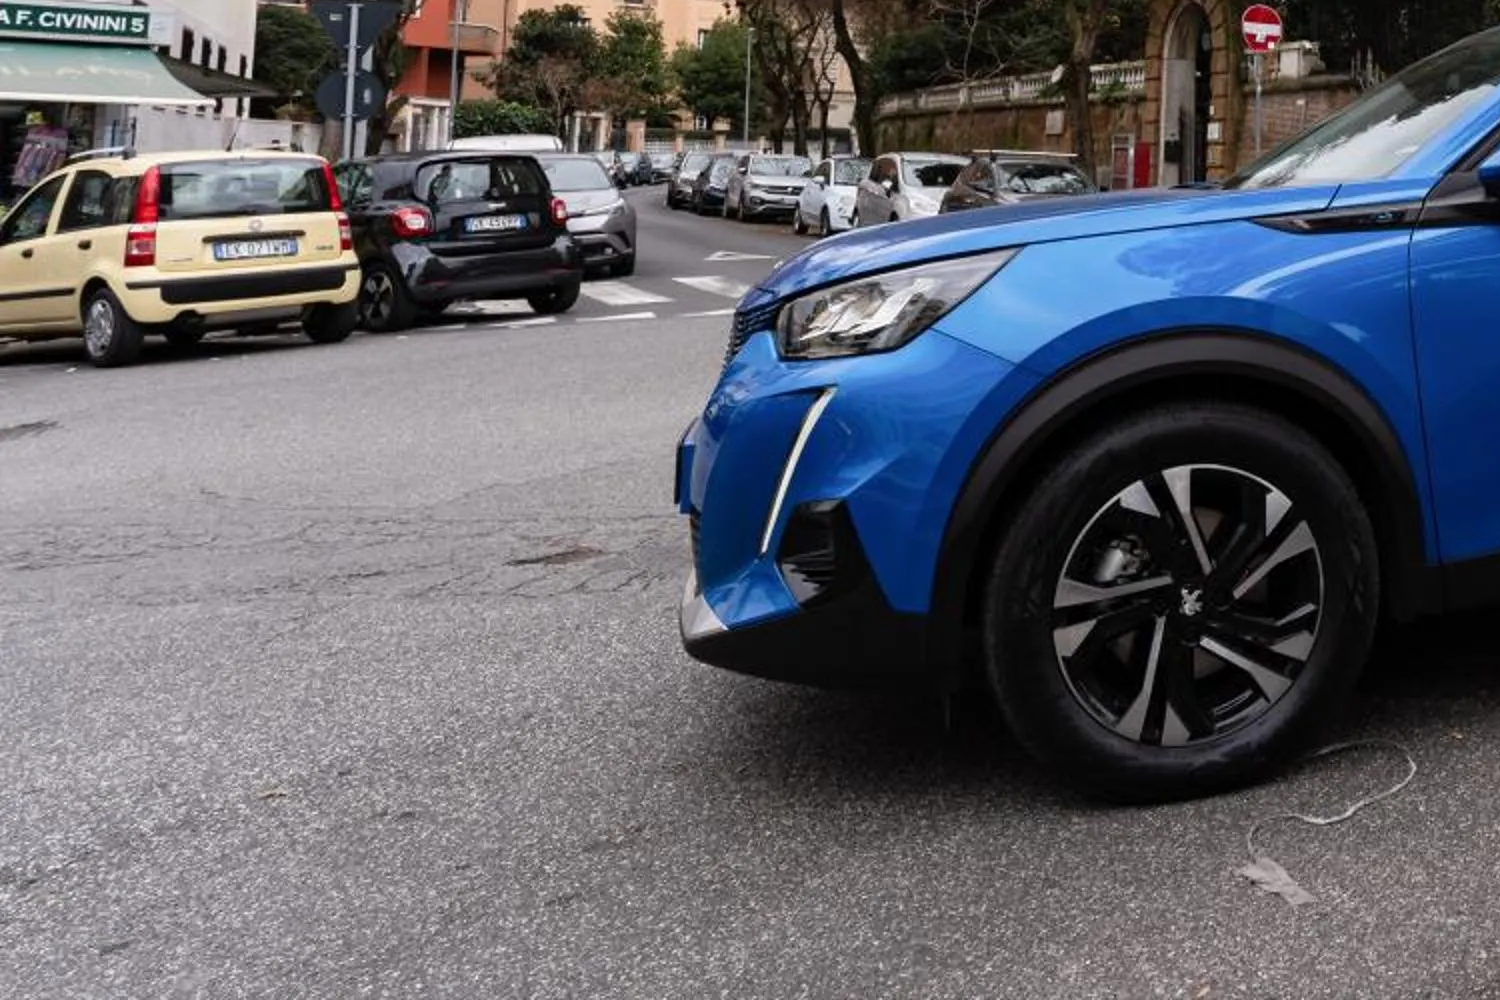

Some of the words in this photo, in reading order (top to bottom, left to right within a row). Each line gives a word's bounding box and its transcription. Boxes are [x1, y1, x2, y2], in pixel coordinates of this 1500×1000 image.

[15, 10, 33, 26] F.
[38, 12, 126, 32] CIVININI
[131, 17, 145, 33] 5
